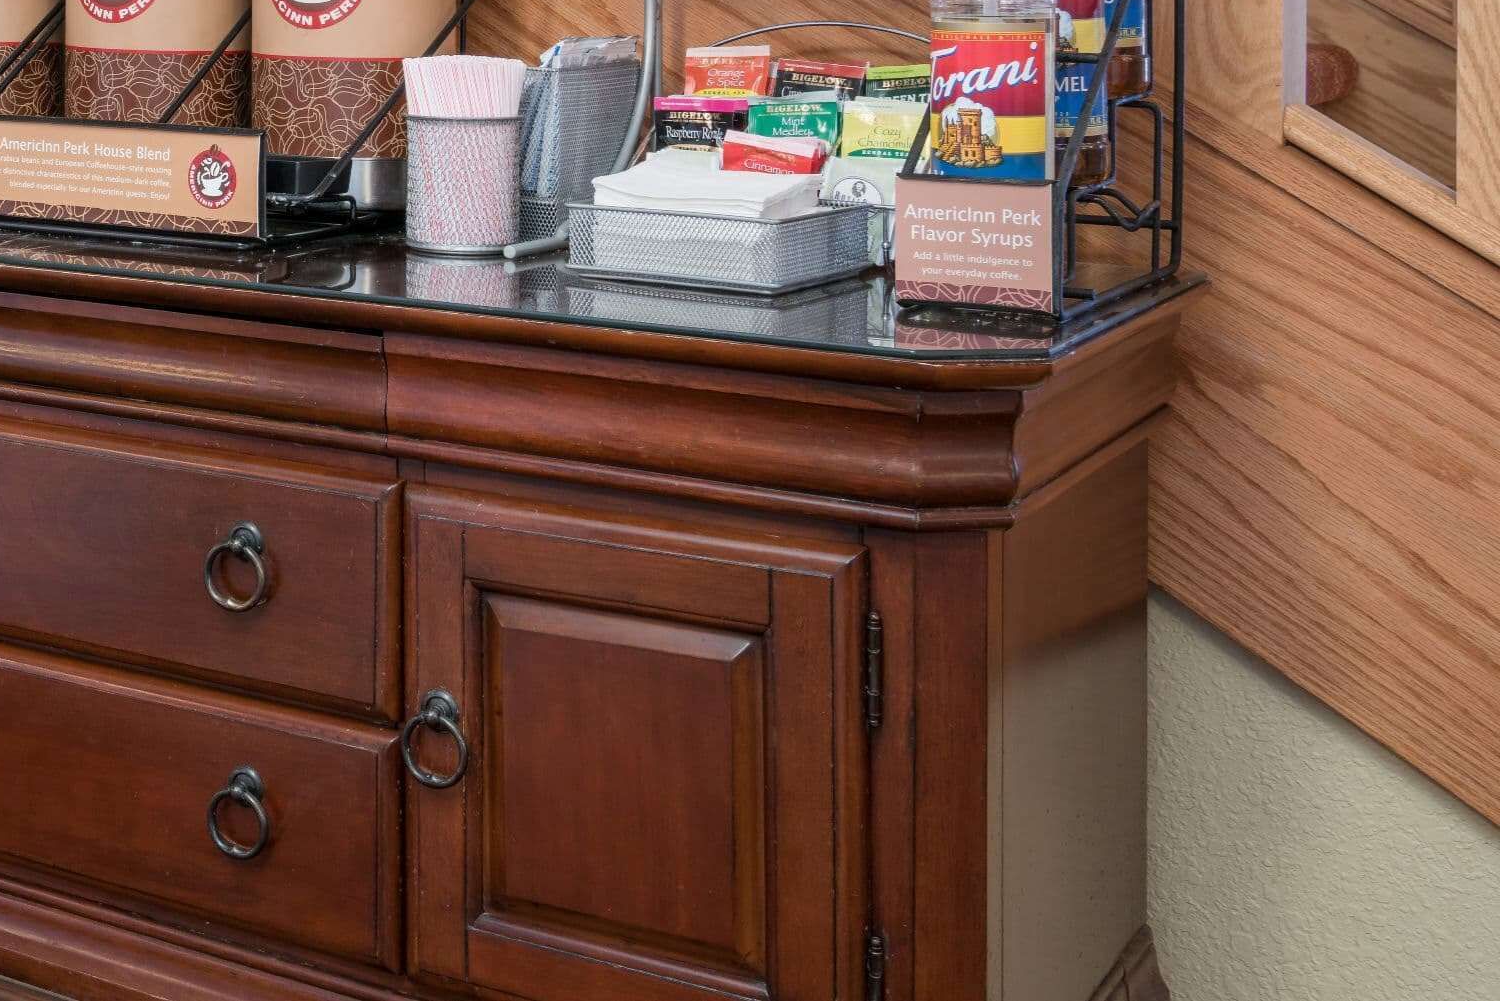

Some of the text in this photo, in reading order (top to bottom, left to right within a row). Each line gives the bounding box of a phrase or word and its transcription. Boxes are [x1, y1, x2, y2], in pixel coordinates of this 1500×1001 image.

[708, 69, 745, 80] Orange
[791, 72, 848, 86] BIGELOW
[930, 41, 1038, 102] Torani
[707, 78, 745, 90] & Spice
[766, 103, 822, 113] BIGELOW
[781, 116, 807, 126] Mint
[666, 125, 700, 141] Raspberry
[772, 125, 809, 137] Medley
[874, 126, 901, 139] Cozy
[0, 137, 170, 161] AmericInn Perk House Blend
[21, 156, 41, 165] beans
[41, 158, 53, 166] and
[53, 159, 85, 168] European
[145, 166, 173, 176] roasting
[2, 167, 35, 177] distinctive
[36, 170, 82, 180] characteristics
[83, 173, 90, 181] of
[91, 173, 104, 182] this
[9, 181, 35, 190] blended
[36, 182, 67, 193] especially
[68, 184, 77, 192] for
[79, 186, 91, 194] our
[150, 191, 171, 201] Enjoy!
[188, 163, 234, 208] AMERICINN PERK
[904, 204, 1042, 226] AmericInn Perk
[911, 225, 1033, 249] Flavor Syrups
[914, 251, 933, 261] Add
[943, 252, 965, 262] little
[967, 255, 1020, 266] indulgence
[1023, 259, 1033, 267] to
[921, 267, 1023, 281] your everyday coffee.
